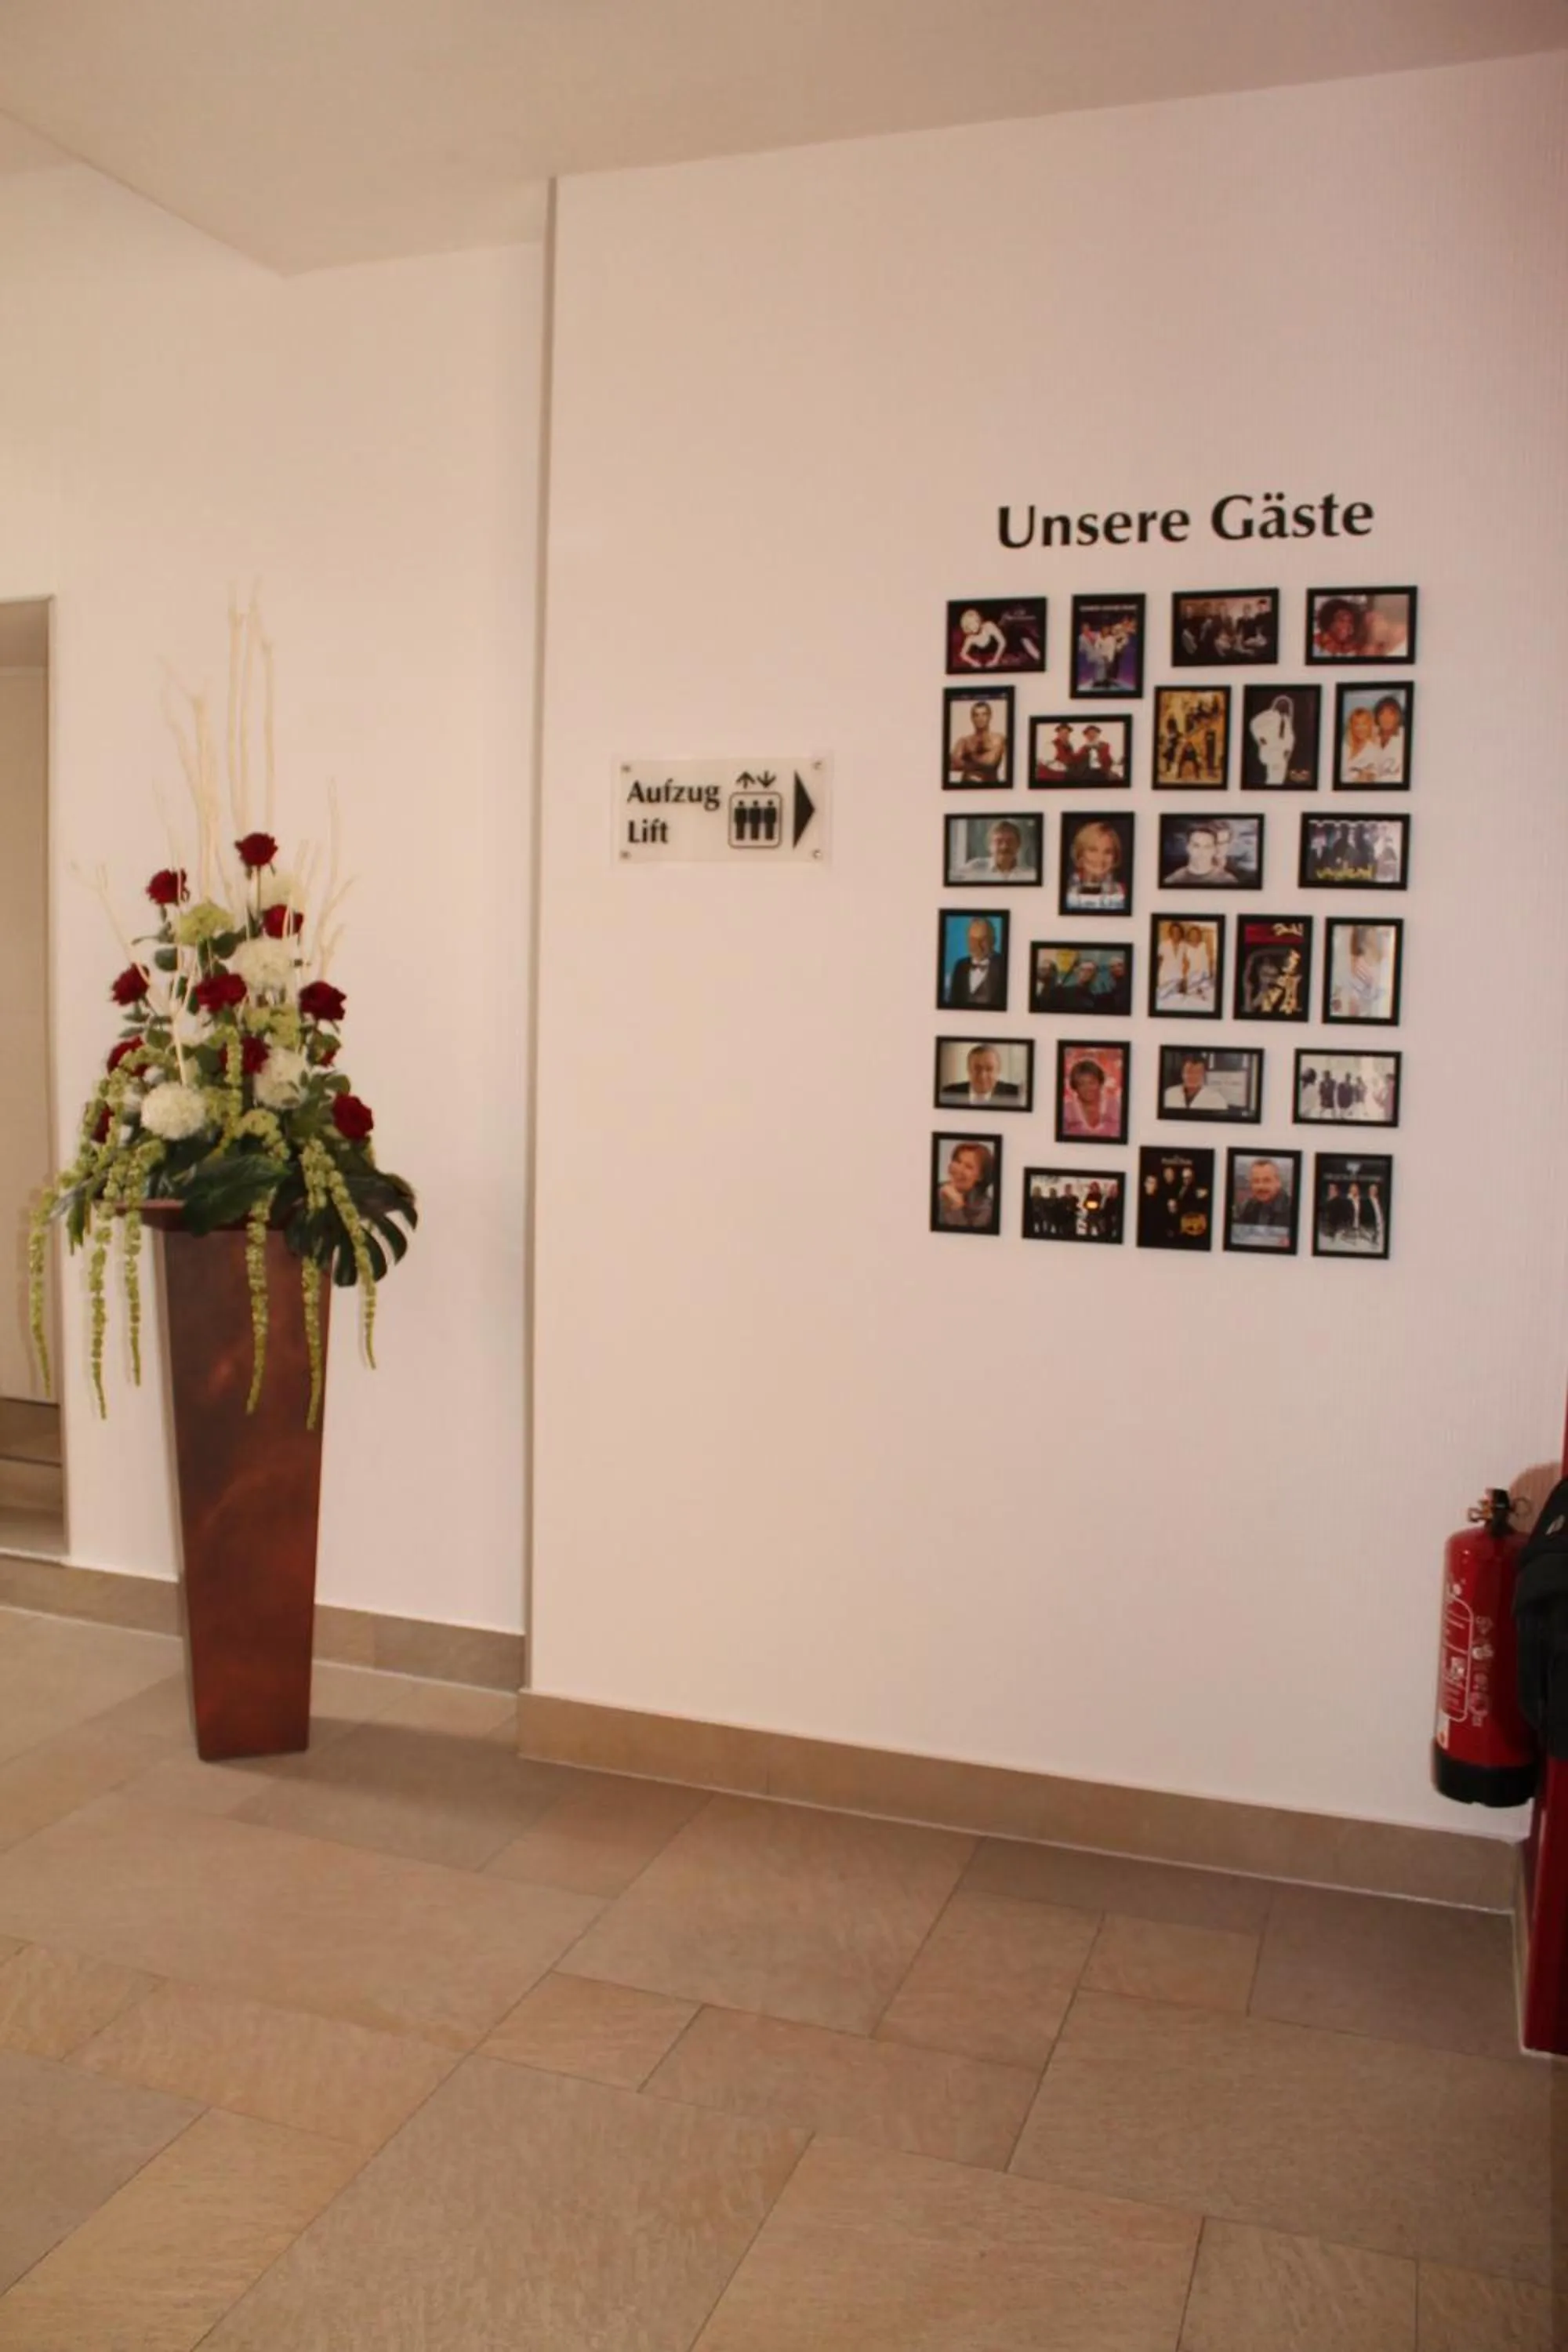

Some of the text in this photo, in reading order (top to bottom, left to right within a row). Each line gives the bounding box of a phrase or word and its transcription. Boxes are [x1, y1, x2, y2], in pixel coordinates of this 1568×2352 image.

[997, 492, 1374, 550] Unsere Gäste
[626, 778, 720, 811] Aufzug
[628, 818, 669, 844] Lift
